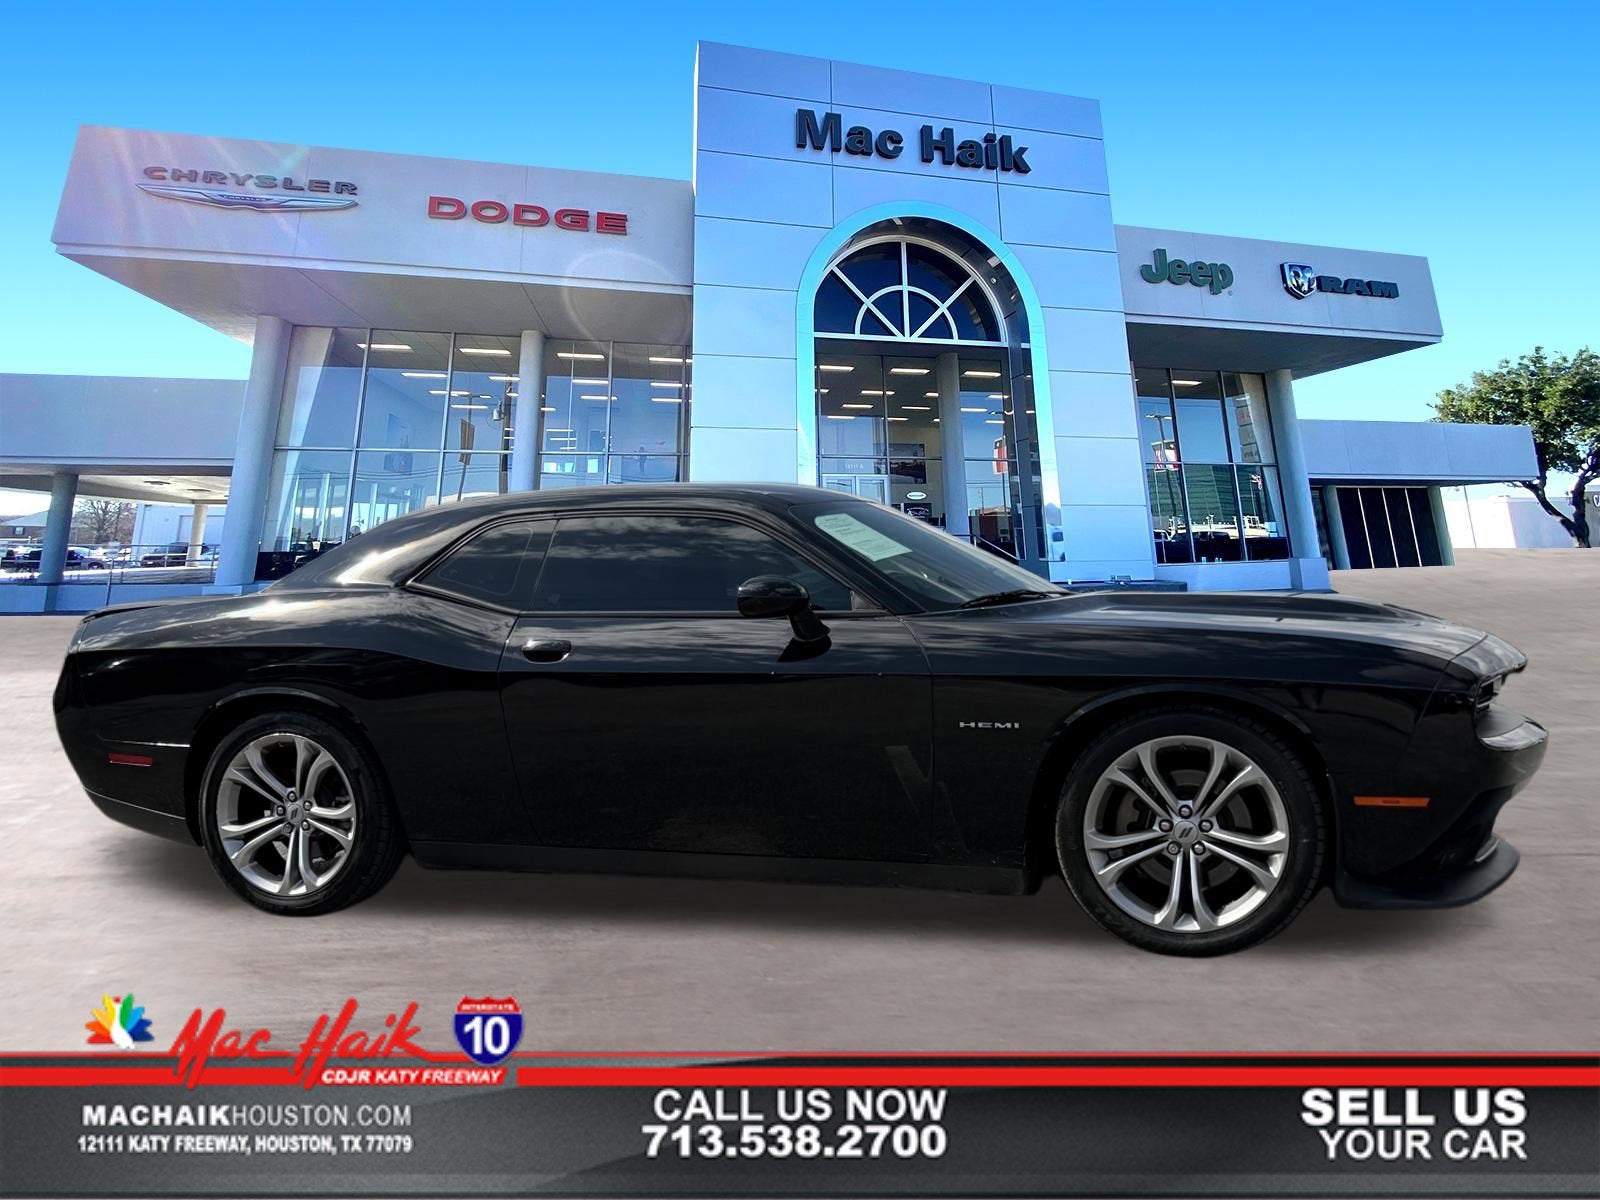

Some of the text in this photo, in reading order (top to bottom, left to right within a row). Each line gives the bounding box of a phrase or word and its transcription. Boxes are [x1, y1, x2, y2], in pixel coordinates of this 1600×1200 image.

[796, 108, 1032, 174] Mac Haik
[143, 166, 359, 196] CHRYSLER
[428, 195, 628, 236] DODGE
[1139, 248, 1234, 295] Jeep
[1315, 275, 1400, 299] RAM
[959, 721, 1020, 729] HEMI
